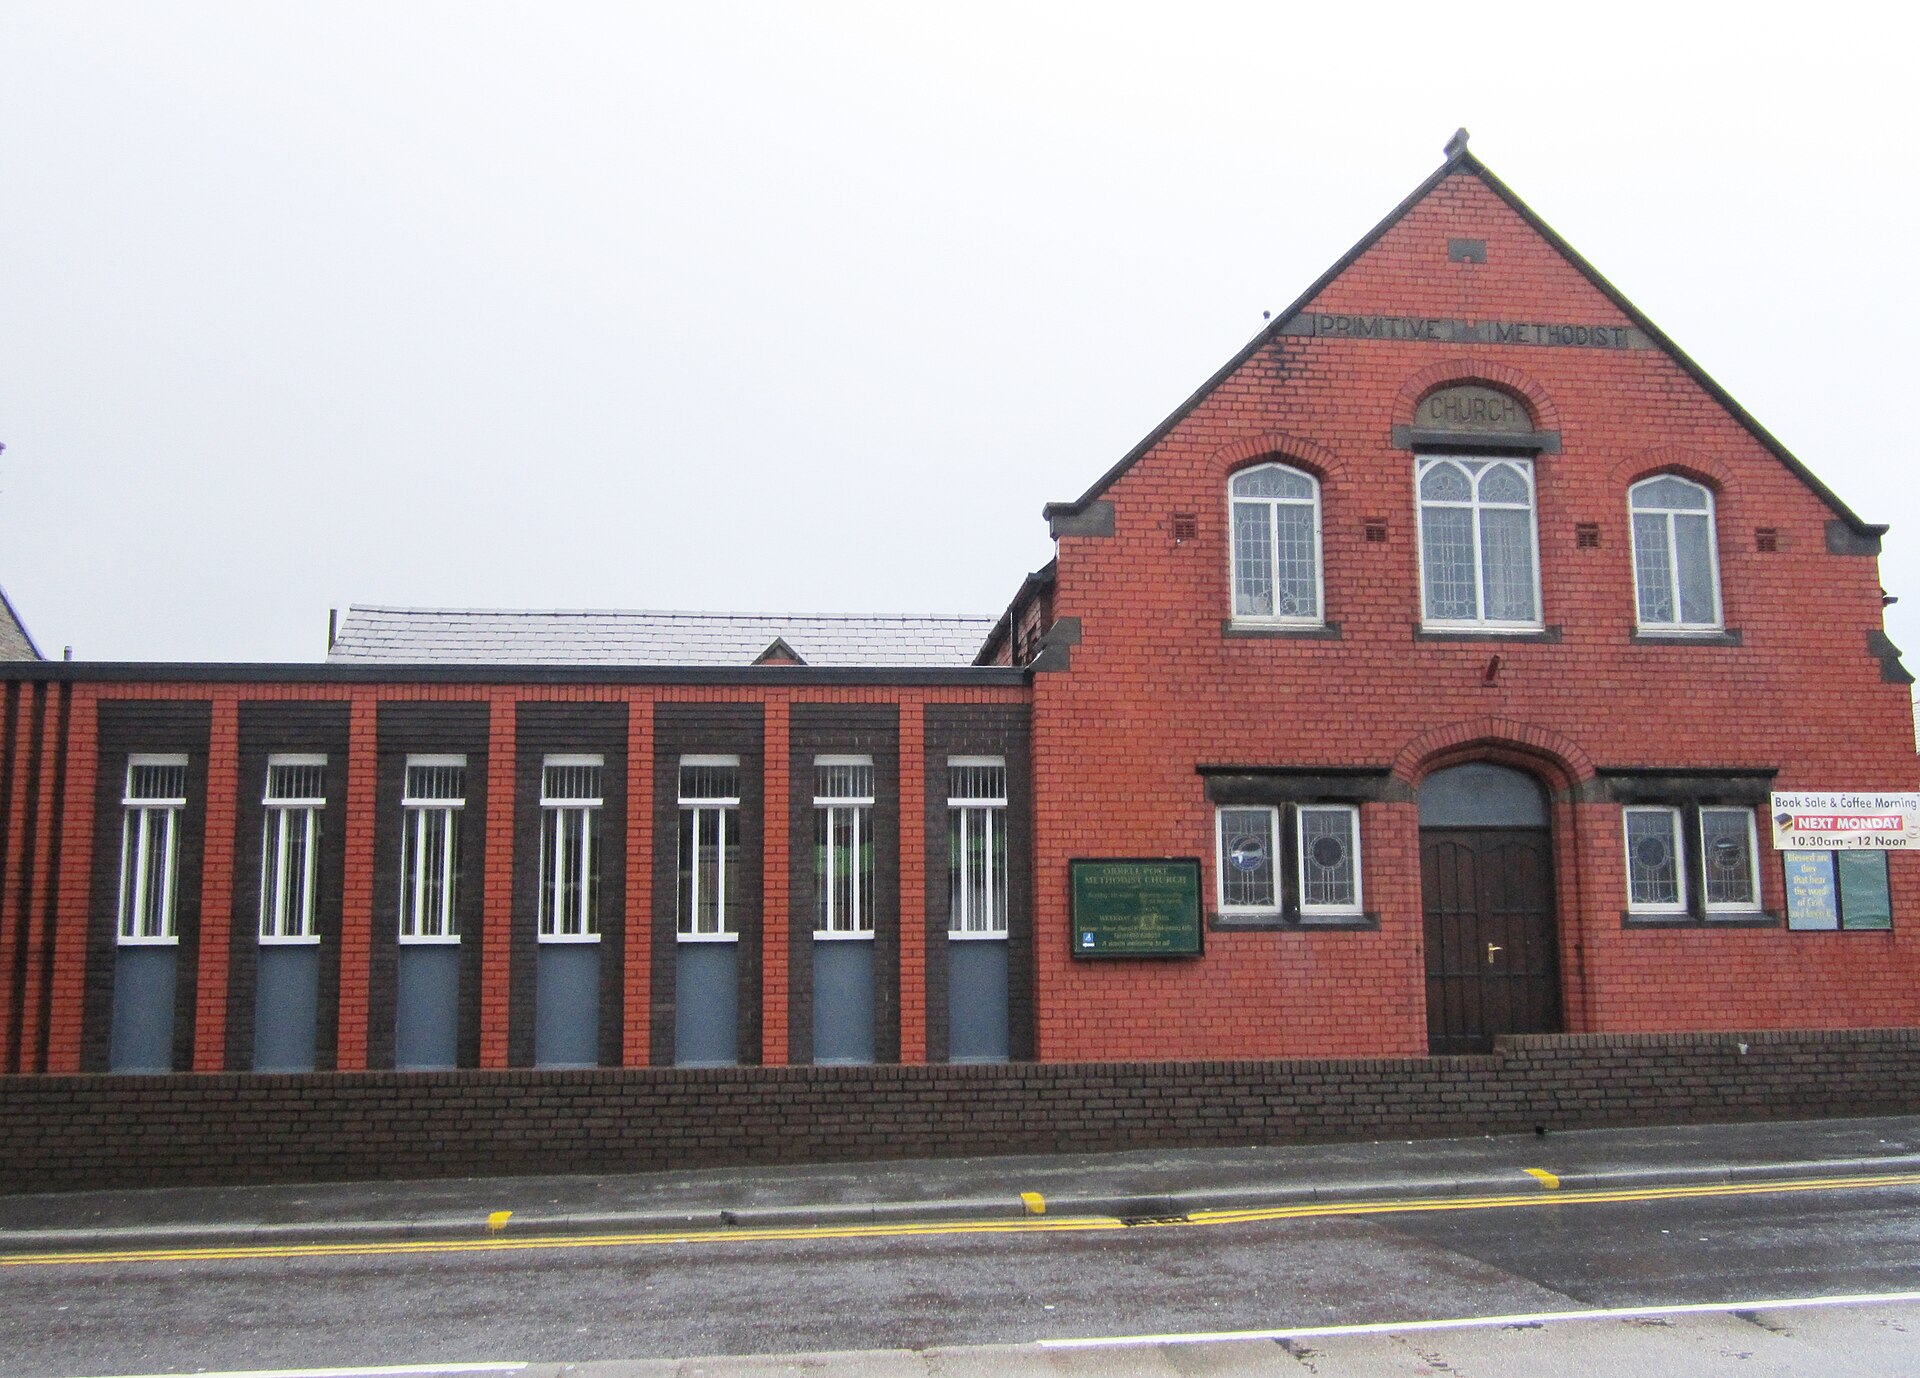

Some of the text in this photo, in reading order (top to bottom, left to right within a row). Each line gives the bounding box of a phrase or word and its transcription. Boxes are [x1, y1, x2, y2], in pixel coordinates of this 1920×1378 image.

[1319, 316, 1624, 347] PRIMITIVE METHODIST
[1429, 396, 1517, 422] CHURCH
[1775, 797, 1917, 810] Book Sale & Coffee Morning
[1798, 817, 1899, 829] NEXT MONDAY
[1791, 836, 1843, 846] 10.30am
[1857, 836, 1871, 846] 12
[1875, 836, 1906, 846] Noon
[1085, 876, 1187, 884] METHODIST CHURCH
